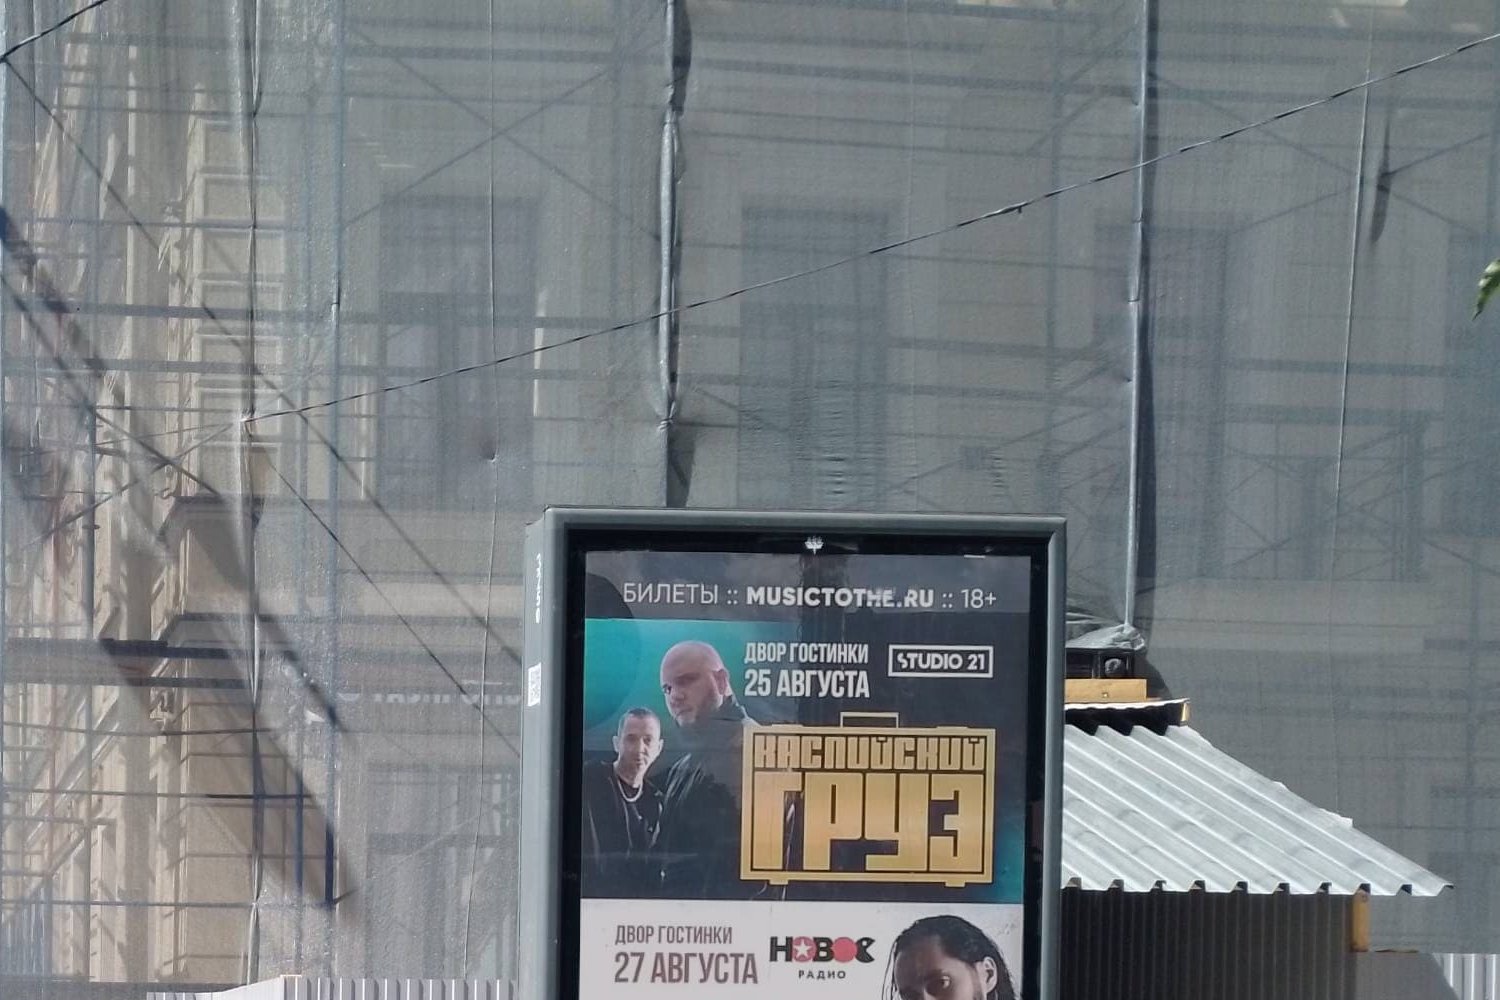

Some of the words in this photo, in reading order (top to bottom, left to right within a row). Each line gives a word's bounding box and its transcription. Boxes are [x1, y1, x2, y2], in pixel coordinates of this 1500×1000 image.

[623, 583, 718, 605] БИЛЕТЫ
[747, 587, 934, 608] MUSICTOTHE.RU
[960, 589, 997, 609] 18+
[744, 642, 787, 665] ДВОР
[789, 643, 869, 665] ГОСТИНКИ
[896, 653, 963, 670] STUDIO
[967, 655, 985, 671] 21
[744, 669, 772, 697] 25
[776, 670, 871, 698] АВГУСТА
[753, 734, 986, 771] КАСПИЙСКИЙ
[752, 771, 985, 872] ГРУЗ
[615, 925, 655, 945] ДВОР
[658, 926, 733, 945] ГОСТИНКИ
[769, 936, 876, 964] НОВОЕ
[614, 952, 645, 983] 27
[651, 952, 759, 985] АВГУСТА
[798, 969, 847, 980] РАДИО
